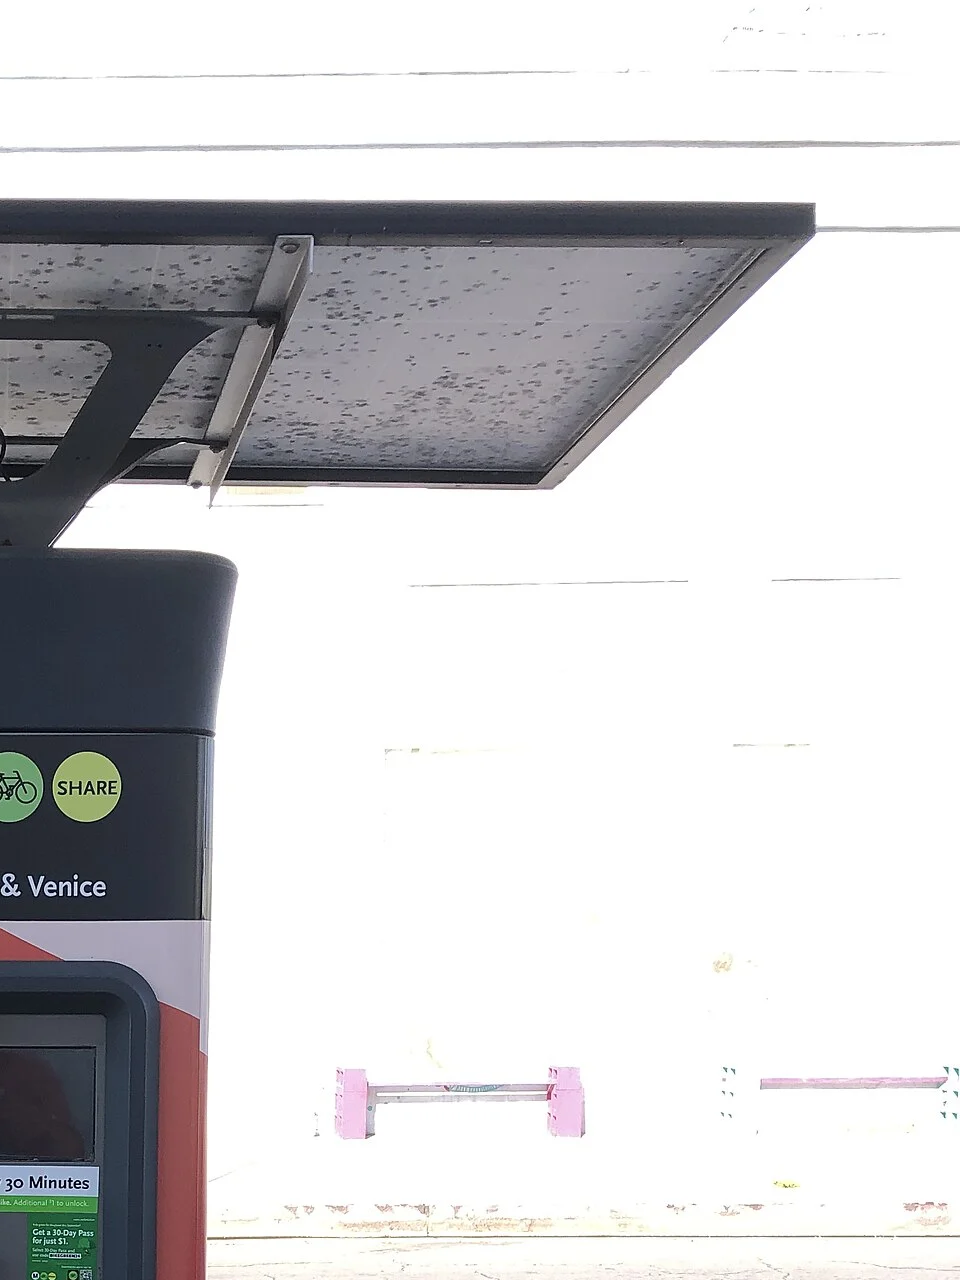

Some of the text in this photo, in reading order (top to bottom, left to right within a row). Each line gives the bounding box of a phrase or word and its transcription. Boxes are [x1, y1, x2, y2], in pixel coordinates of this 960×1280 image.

[57, 779, 118, 796] SHARE
[0, 874, 21, 897] &
[28, 875, 106, 898] Venice
[5, 1178, 24, 1191] 30
[29, 1176, 90, 1190] Minutes
[52, 1229, 76, 1238] 30-Day
[43, 1237, 56, 1246] just
